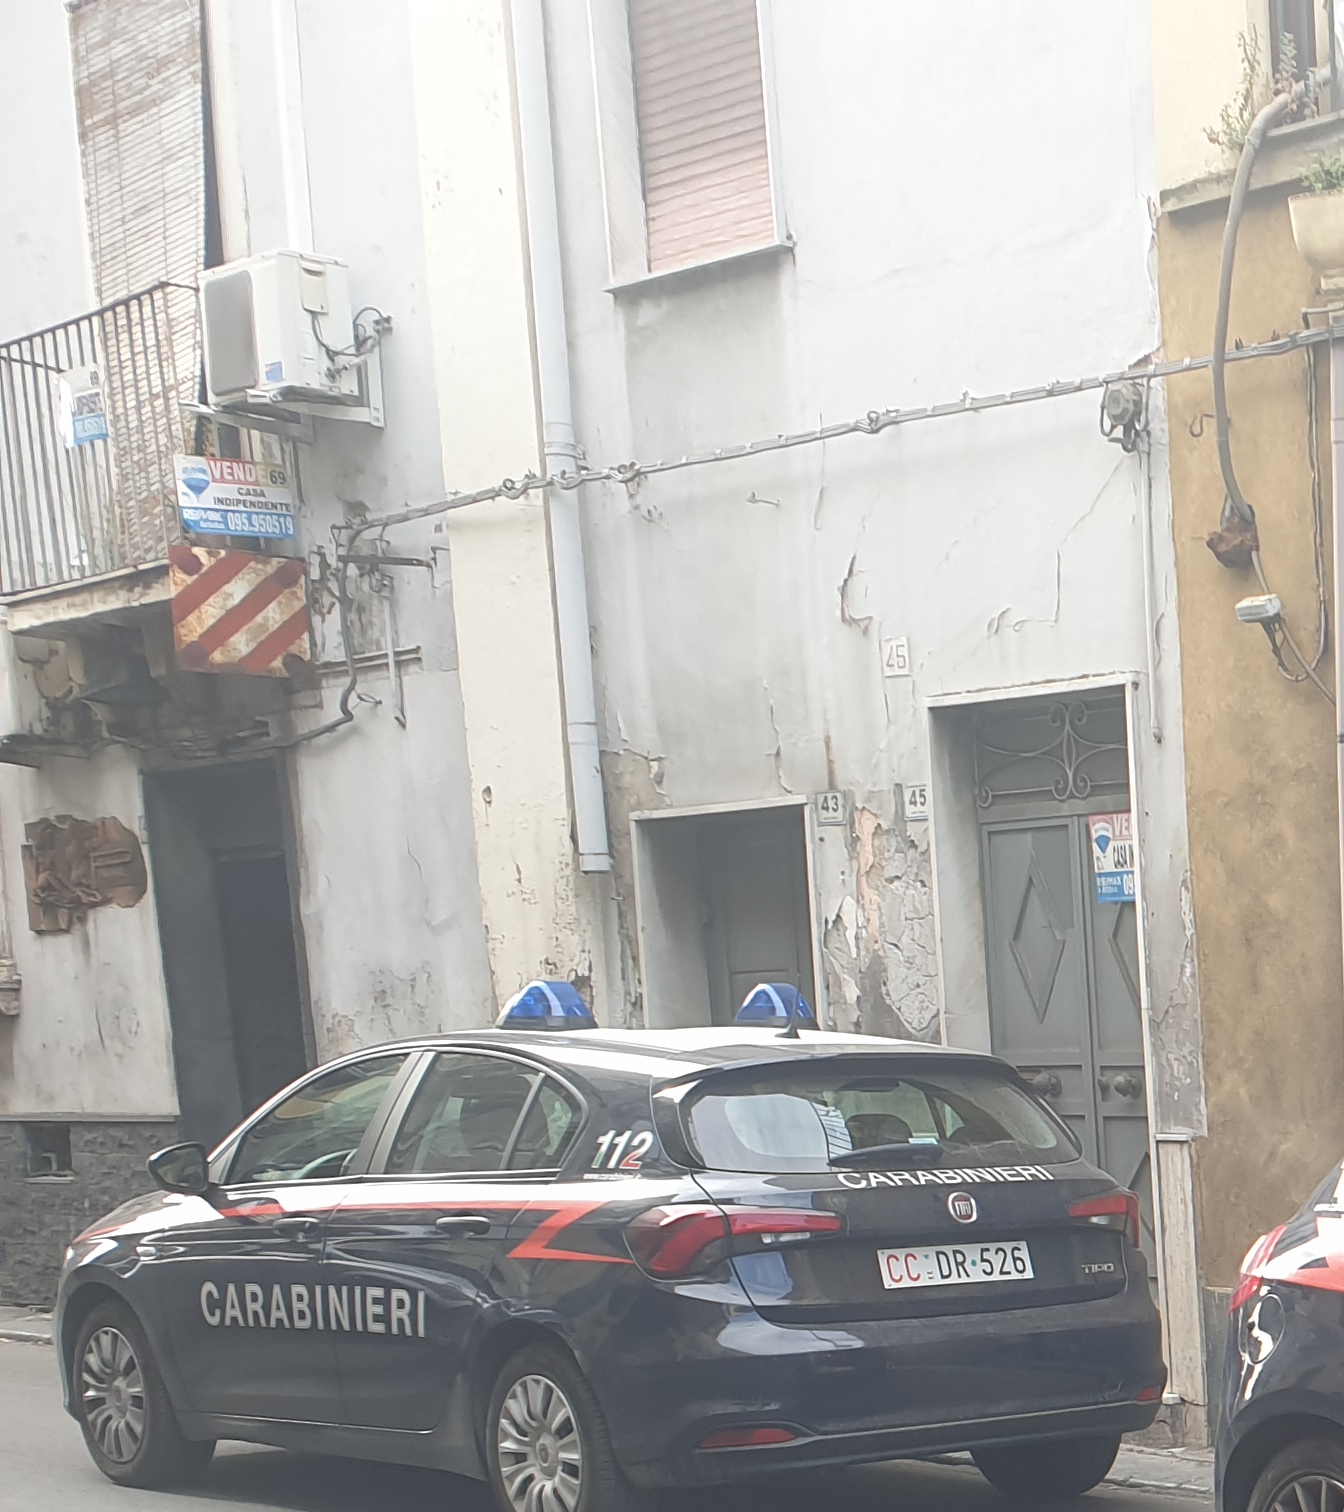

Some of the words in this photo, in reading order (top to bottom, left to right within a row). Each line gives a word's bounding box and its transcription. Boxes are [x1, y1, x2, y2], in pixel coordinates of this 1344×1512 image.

[269, 470, 287, 485] 69
[237, 487, 266, 498] CASA
[213, 496, 292, 512] INDIPENDENTE
[821, 794, 839, 813] 43
[909, 788, 927, 807] 45
[591, 1129, 654, 1170] 112
[837, 1164, 1055, 1189] CARABINIERI
[886, 1252, 922, 1283] CC
[935, 1249, 971, 1280] DR
[979, 1246, 1027, 1276] 526
[200, 1281, 426, 1338] CARABINIERI
